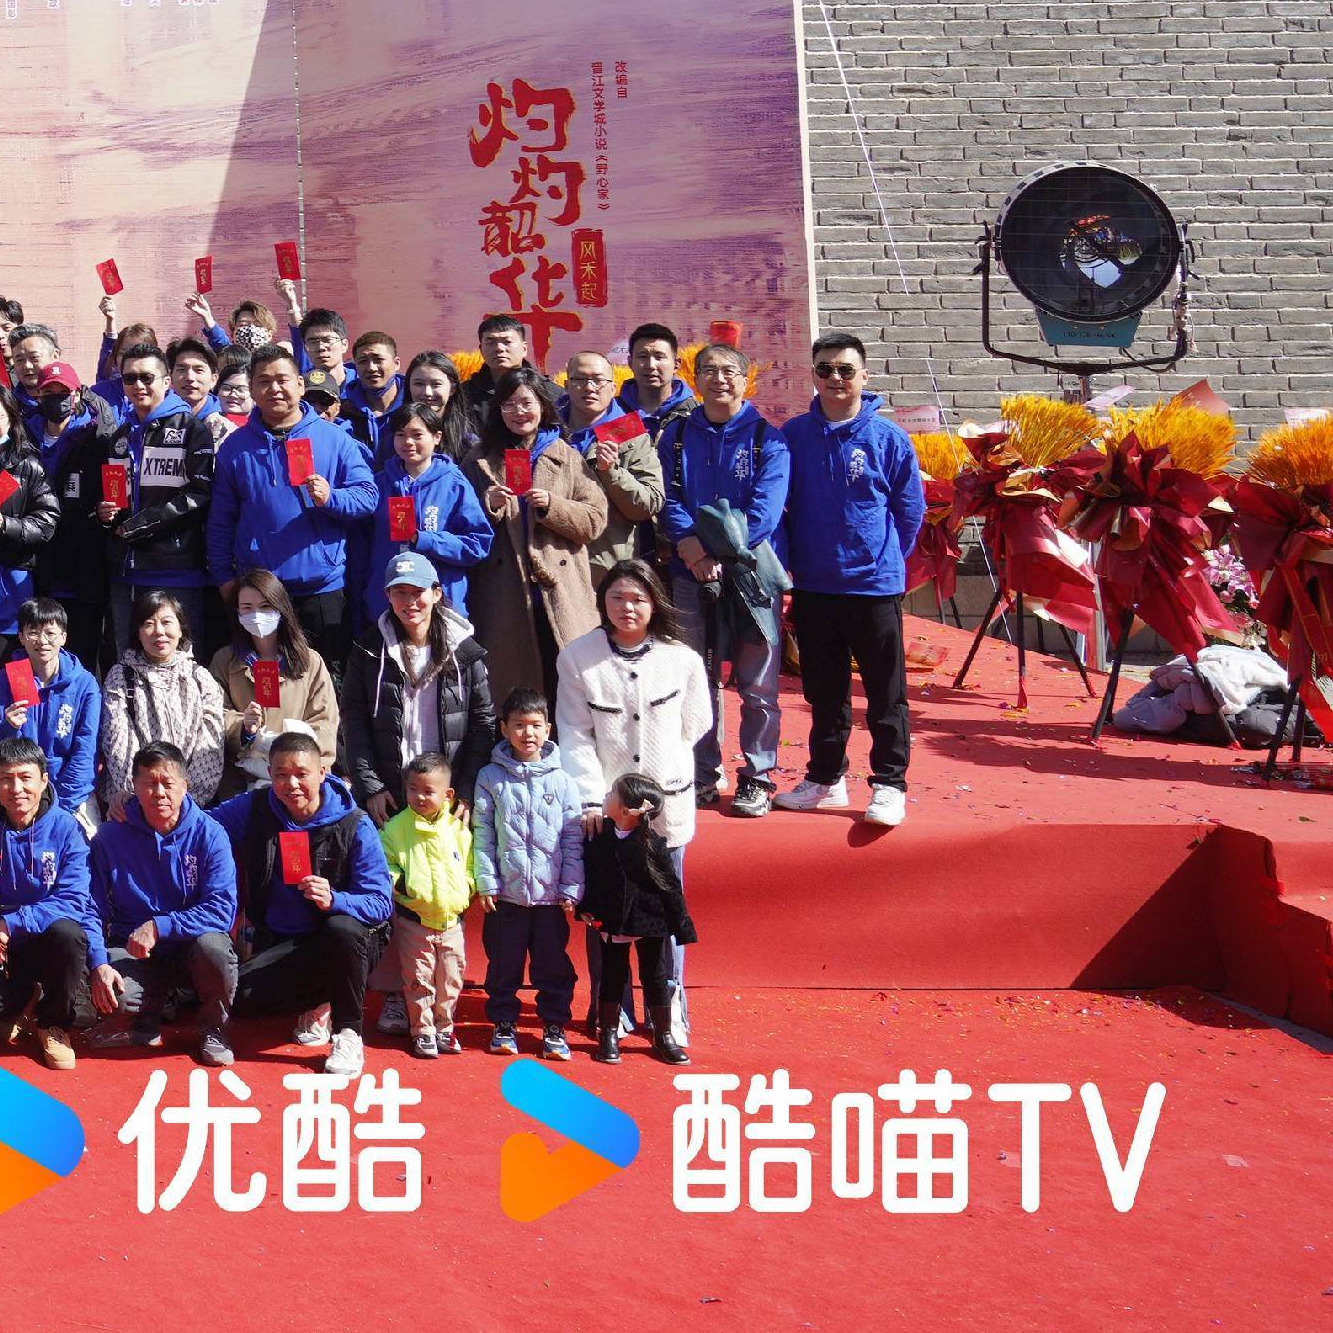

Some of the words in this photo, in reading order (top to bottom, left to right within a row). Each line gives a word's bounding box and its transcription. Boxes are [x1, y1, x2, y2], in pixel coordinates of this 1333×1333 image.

[614, 60, 629, 100] 改编自
[590, 61, 611, 211] 晋江文学城小说《野心家》
[469, 78, 586, 374] 灼灼韶华
[579, 240, 598, 302] 风禾起
